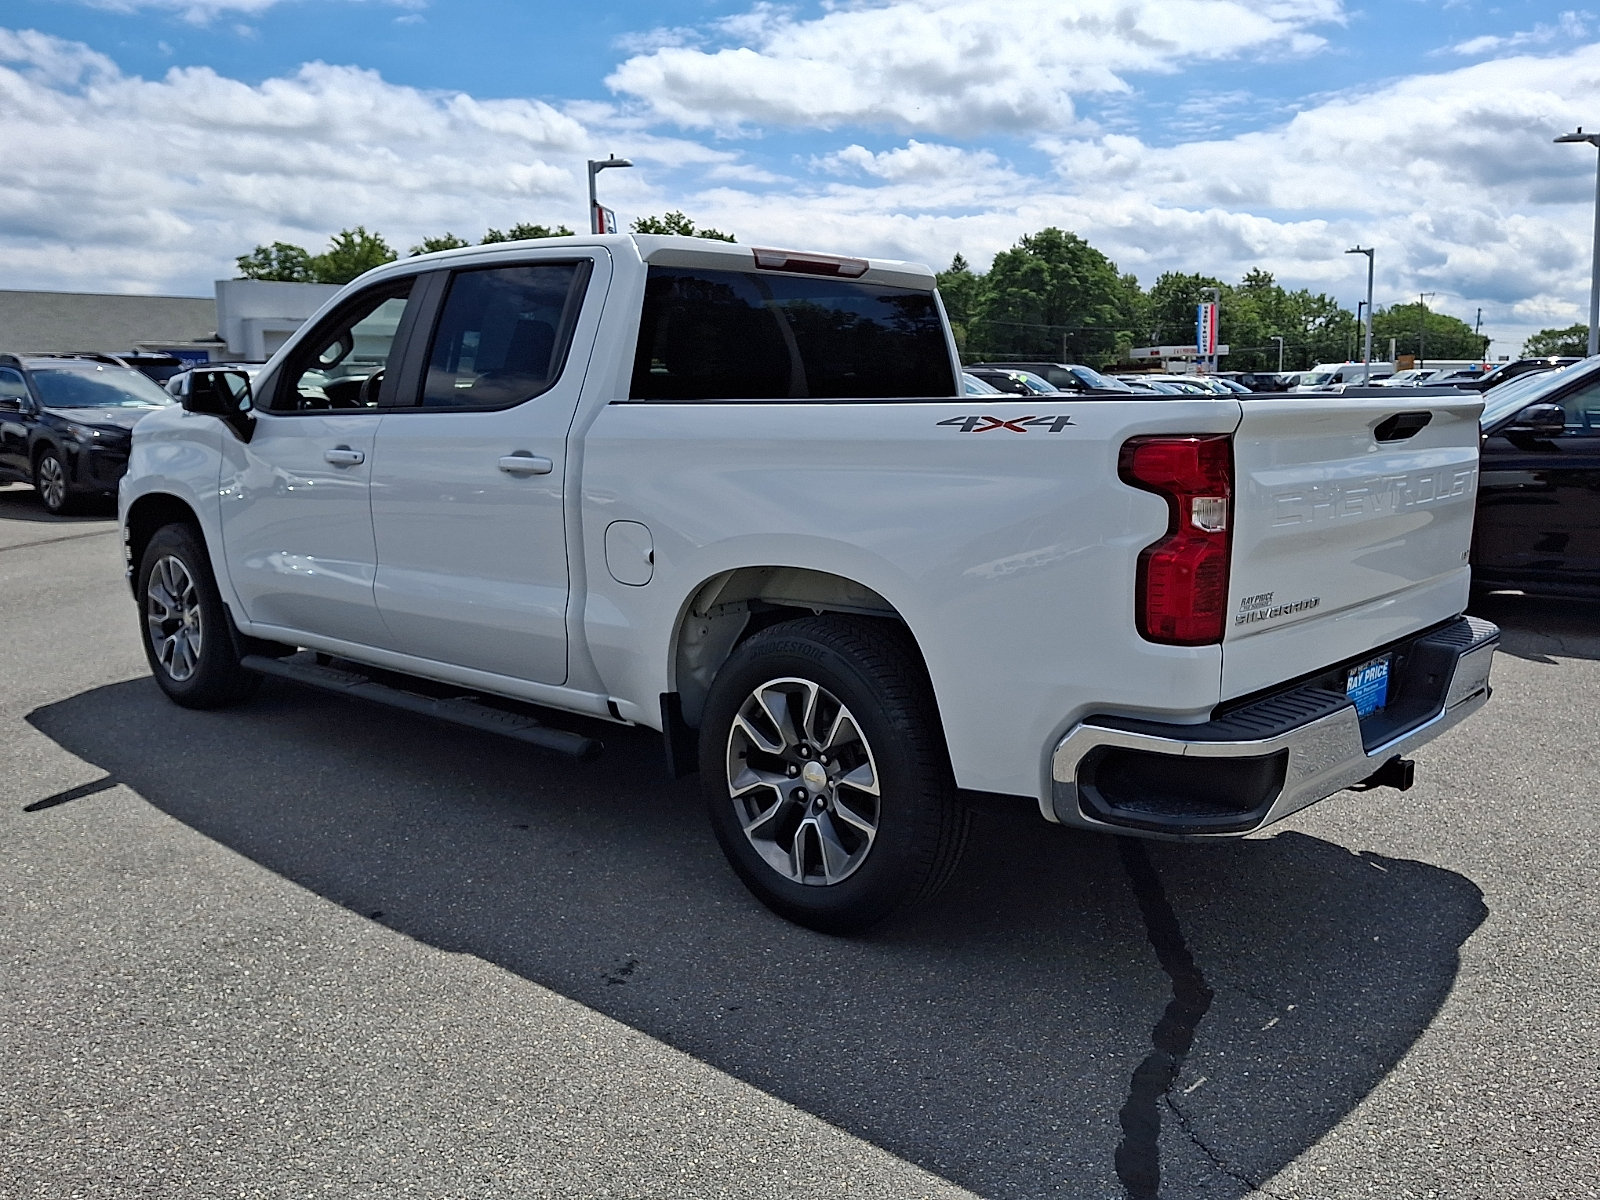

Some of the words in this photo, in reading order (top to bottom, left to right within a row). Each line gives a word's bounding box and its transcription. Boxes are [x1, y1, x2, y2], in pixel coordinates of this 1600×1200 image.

[1272, 466, 1477, 528] CHEVROLET
[1234, 595, 1321, 627] SILVERADO
[1241, 595, 1255, 606] RAY
[1255, 591, 1274, 603] PRICE
[1347, 671, 1363, 691] RAY
[1364, 661, 1389, 684] PRICE
